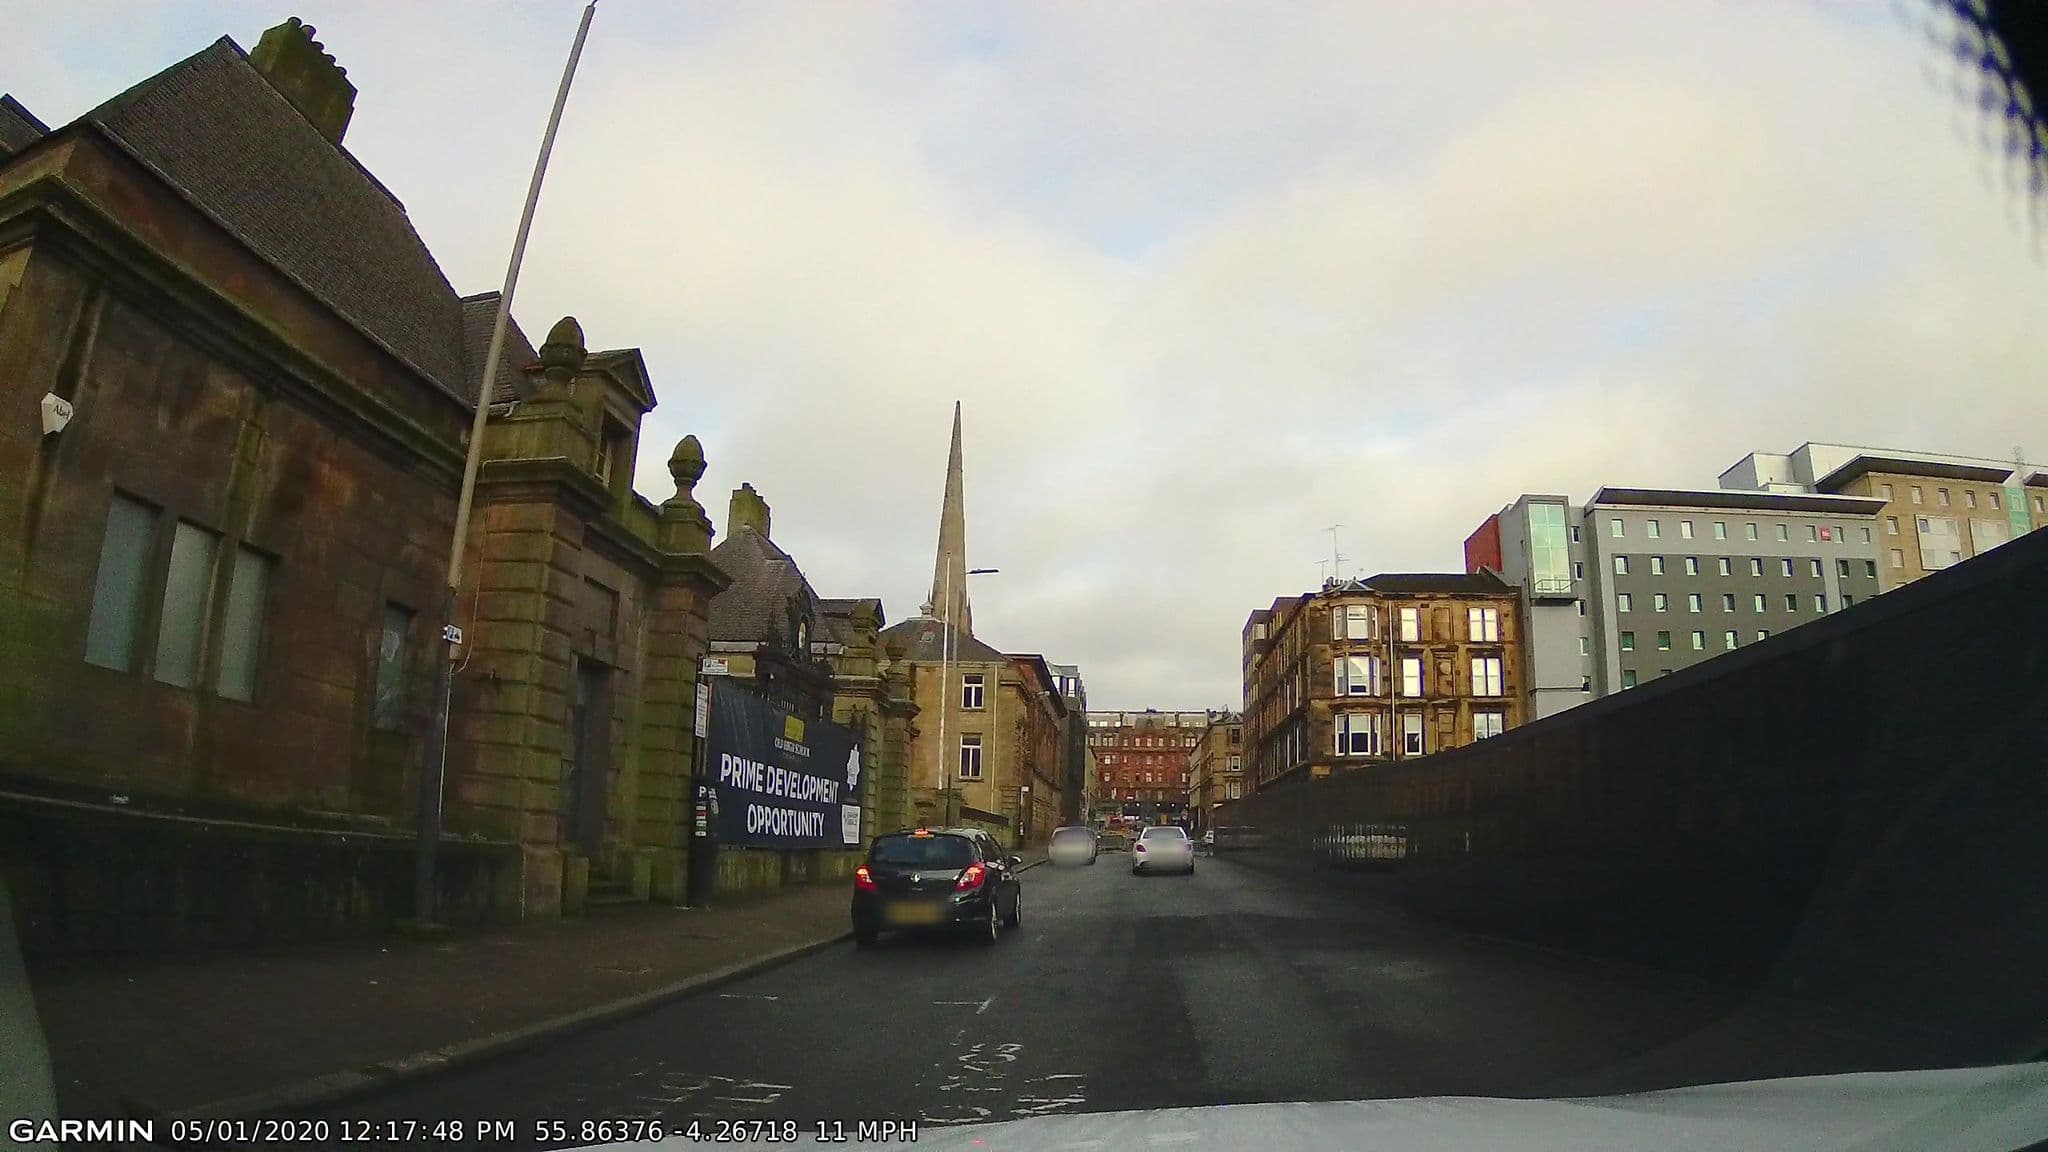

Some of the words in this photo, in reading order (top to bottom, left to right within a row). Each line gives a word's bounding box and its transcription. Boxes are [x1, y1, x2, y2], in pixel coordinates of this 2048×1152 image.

[720, 753, 764, 793] PRIME
[766, 766, 840, 804] DEVELOPMENT
[747, 803, 824, 837] OPPORTUNITY
